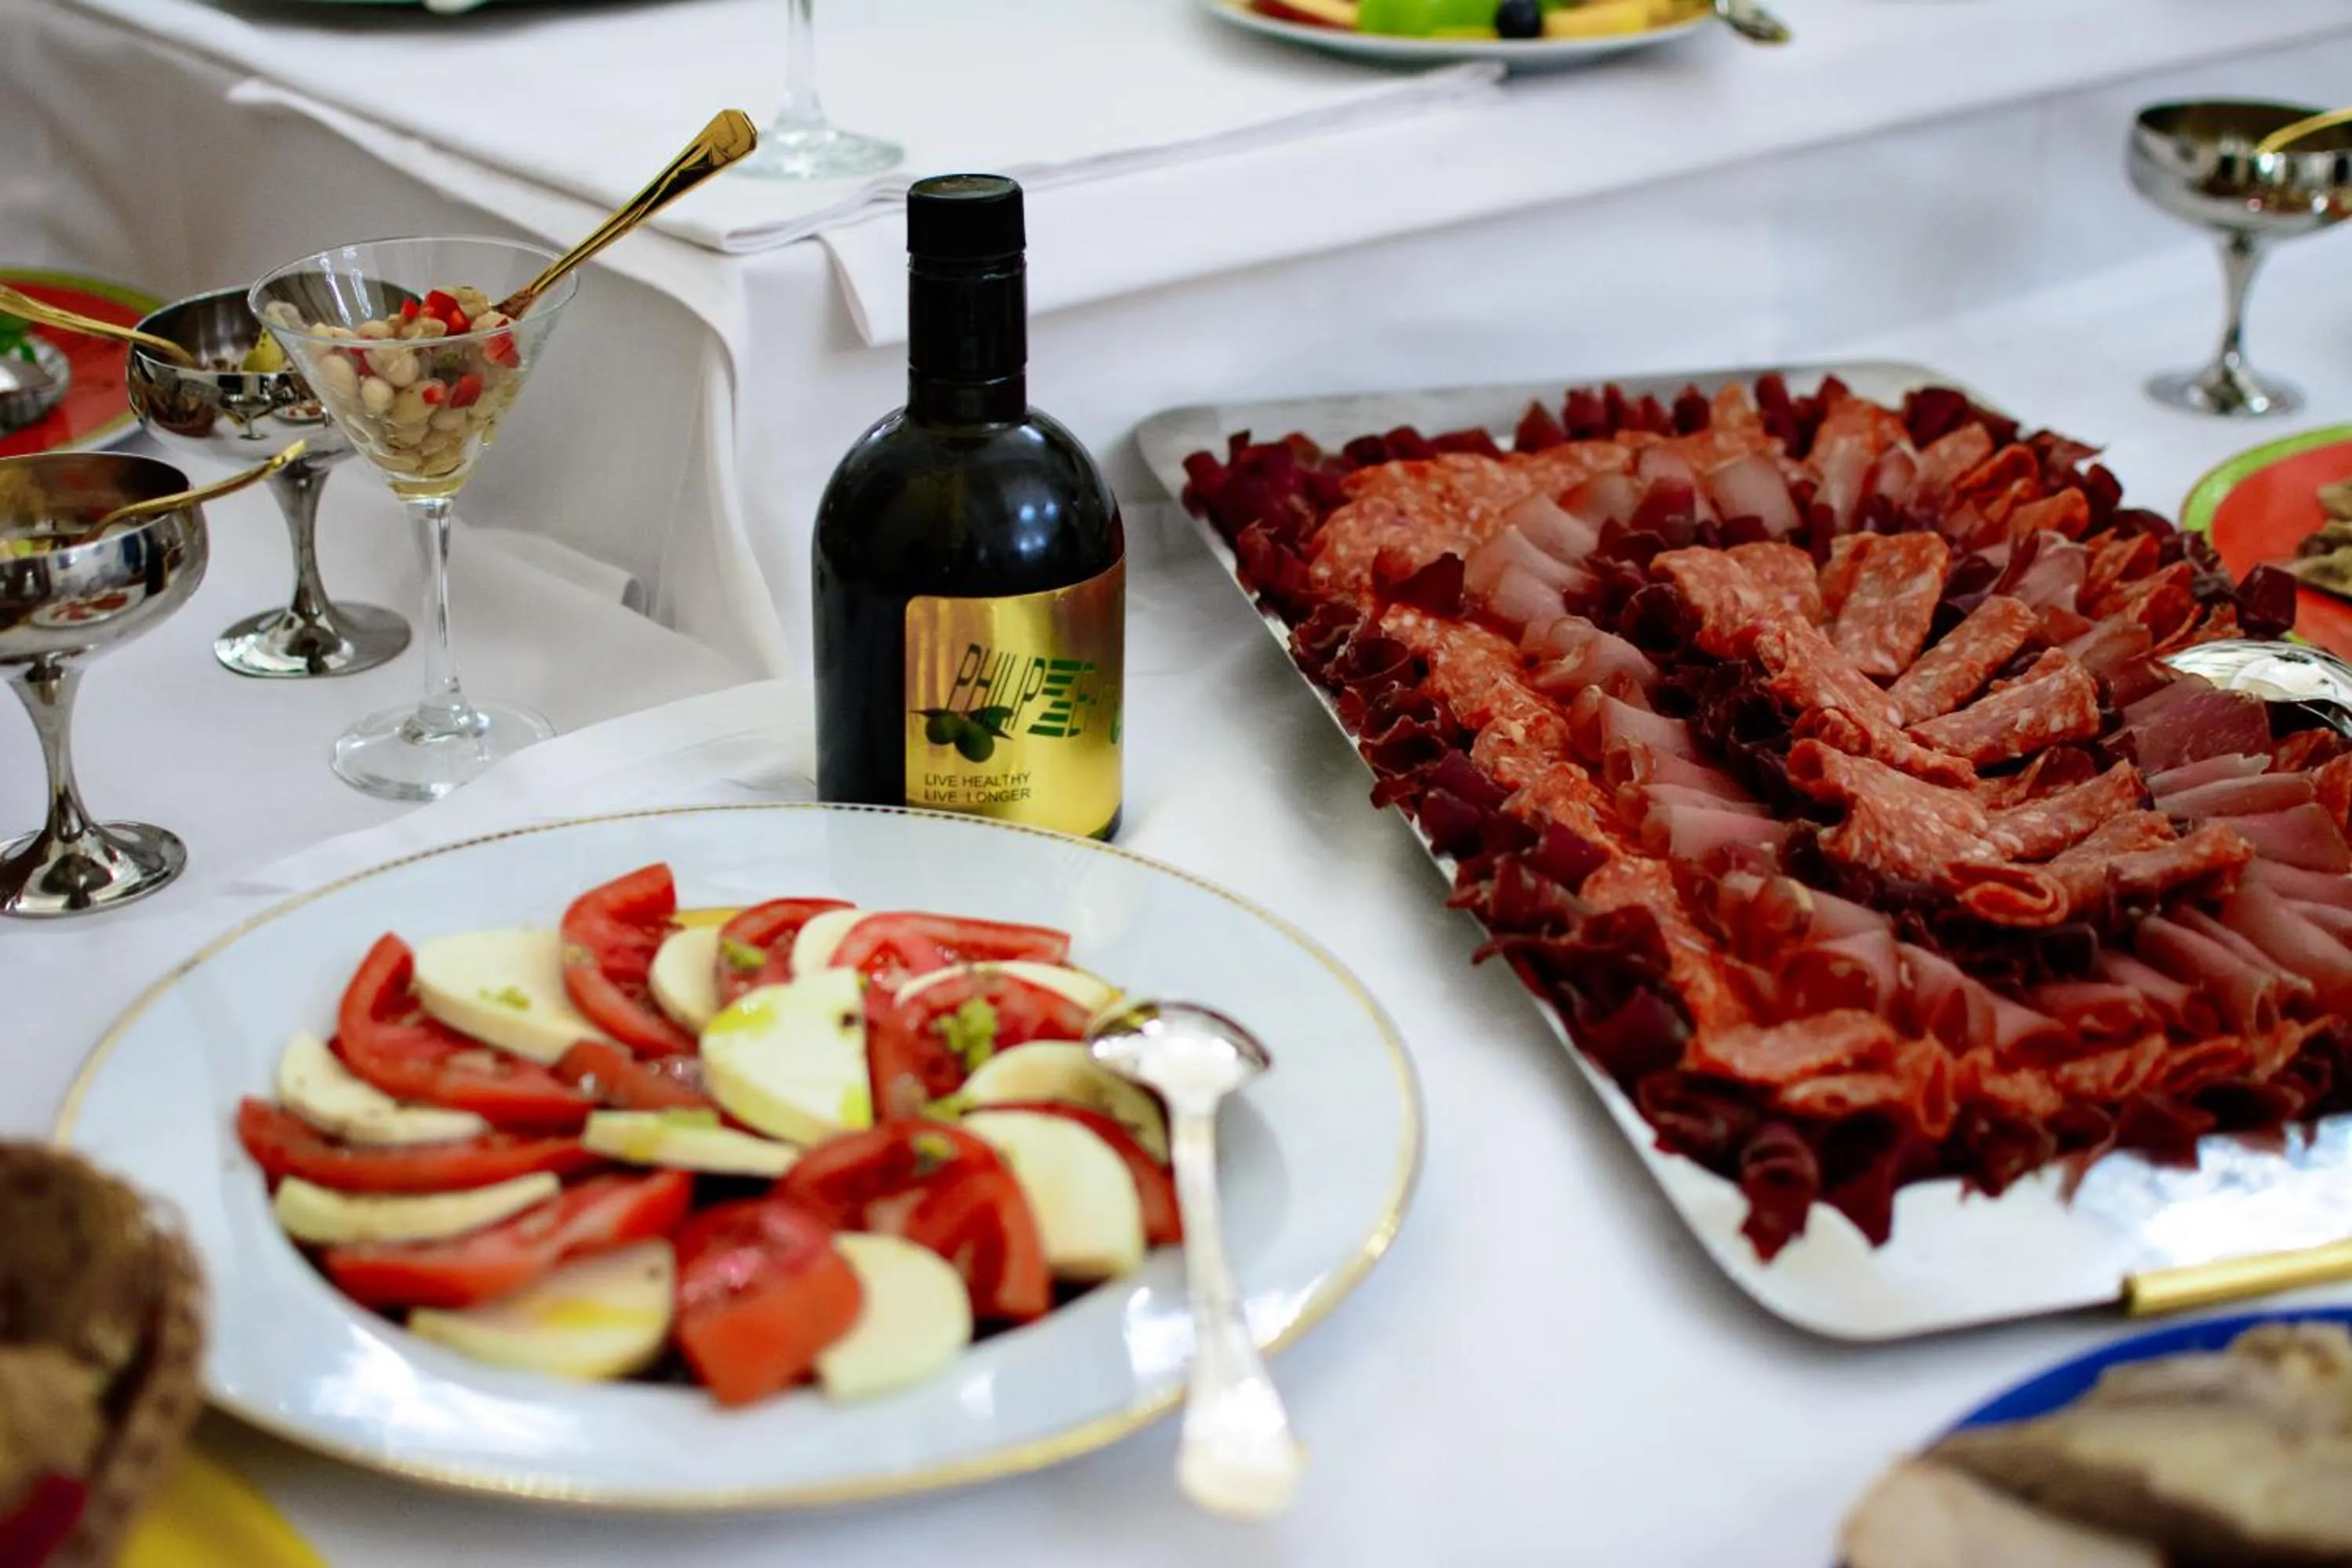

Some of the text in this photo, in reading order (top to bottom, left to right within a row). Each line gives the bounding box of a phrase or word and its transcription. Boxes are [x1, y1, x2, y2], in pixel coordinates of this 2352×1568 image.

[924, 771, 1031, 788] LIVE HEALTHY
[924, 787, 1031, 804] LIVE LONGER
